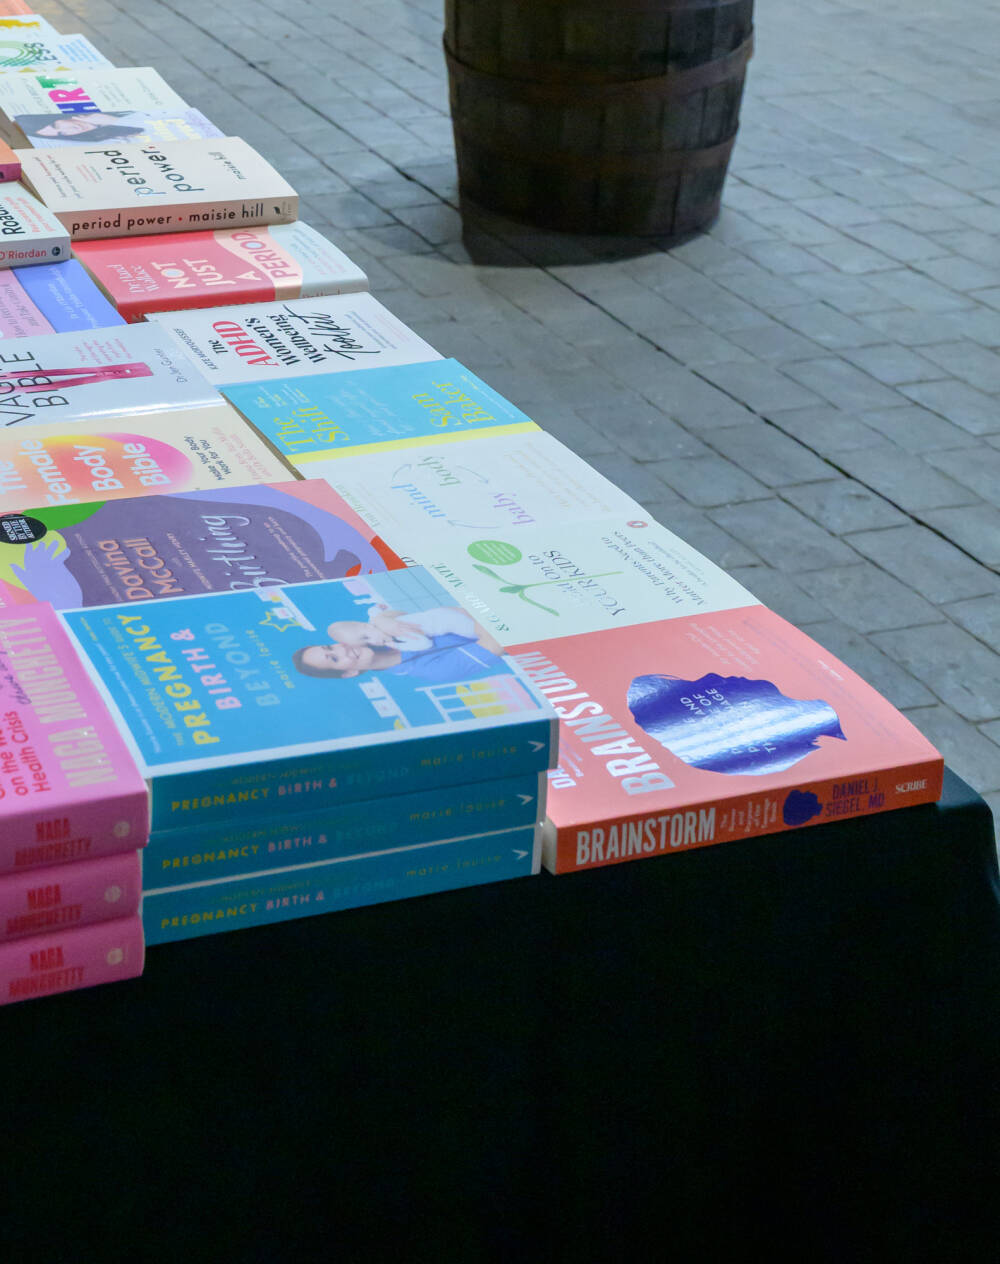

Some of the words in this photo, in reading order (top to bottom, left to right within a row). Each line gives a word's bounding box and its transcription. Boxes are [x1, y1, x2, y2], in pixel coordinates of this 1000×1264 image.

[36, 75, 101, 113] HRT
[84, 149, 167, 196] period
[72, 213, 121, 234] period
[127, 215, 172, 230] power
[189, 209, 236, 222] maisie
[241, 203, 264, 217] hill
[151, 261, 197, 289] NOT
[183, 258, 236, 286] JUST
[208, 339, 228, 355] The
[212, 321, 280, 367] ADHD
[245, 317, 301, 366] Women's
[270, 314, 327, 363] Wellbeing
[282, 303, 381, 360] Toolkit
[412, 392, 462, 427] Sam
[432, 380, 496, 425] Baker
[295, 405, 351, 445] Shift
[18, 439, 80, 506] Female
[73, 444, 125, 492] Body
[122, 441, 172, 486] Bible
[418, 455, 462, 487] body
[390, 483, 447, 519] mind
[493, 492, 536, 526] baby
[100, 541, 153, 600] Davina
[124, 536, 184, 596] McCall
[170, 628, 194, 640] &
[117, 614, 220, 745] PREGNANCY
[190, 647, 242, 711] BIRTH
[204, 623, 281, 707] BEYOND
[3, 711, 28, 743] Crisis
[521, 650, 677, 796] BRAINSTORM
[0, 751, 18, 773] the
[19, 746, 50, 792] Health
[48, 725, 118, 787] NAGA
[10, 776, 28, 795] on
[172, 786, 271, 813] PREGNANCY
[277, 780, 323, 797] BIRTH
[327, 778, 338, 790] &
[895, 778, 928, 795] SCRIBE
[36, 817, 71, 841] NAGA
[576, 807, 716, 866] BRAINSTORM
[162, 843, 260, 870] PREGNANCY
[267, 837, 313, 854] BIRTH
[318, 834, 328, 846] &
